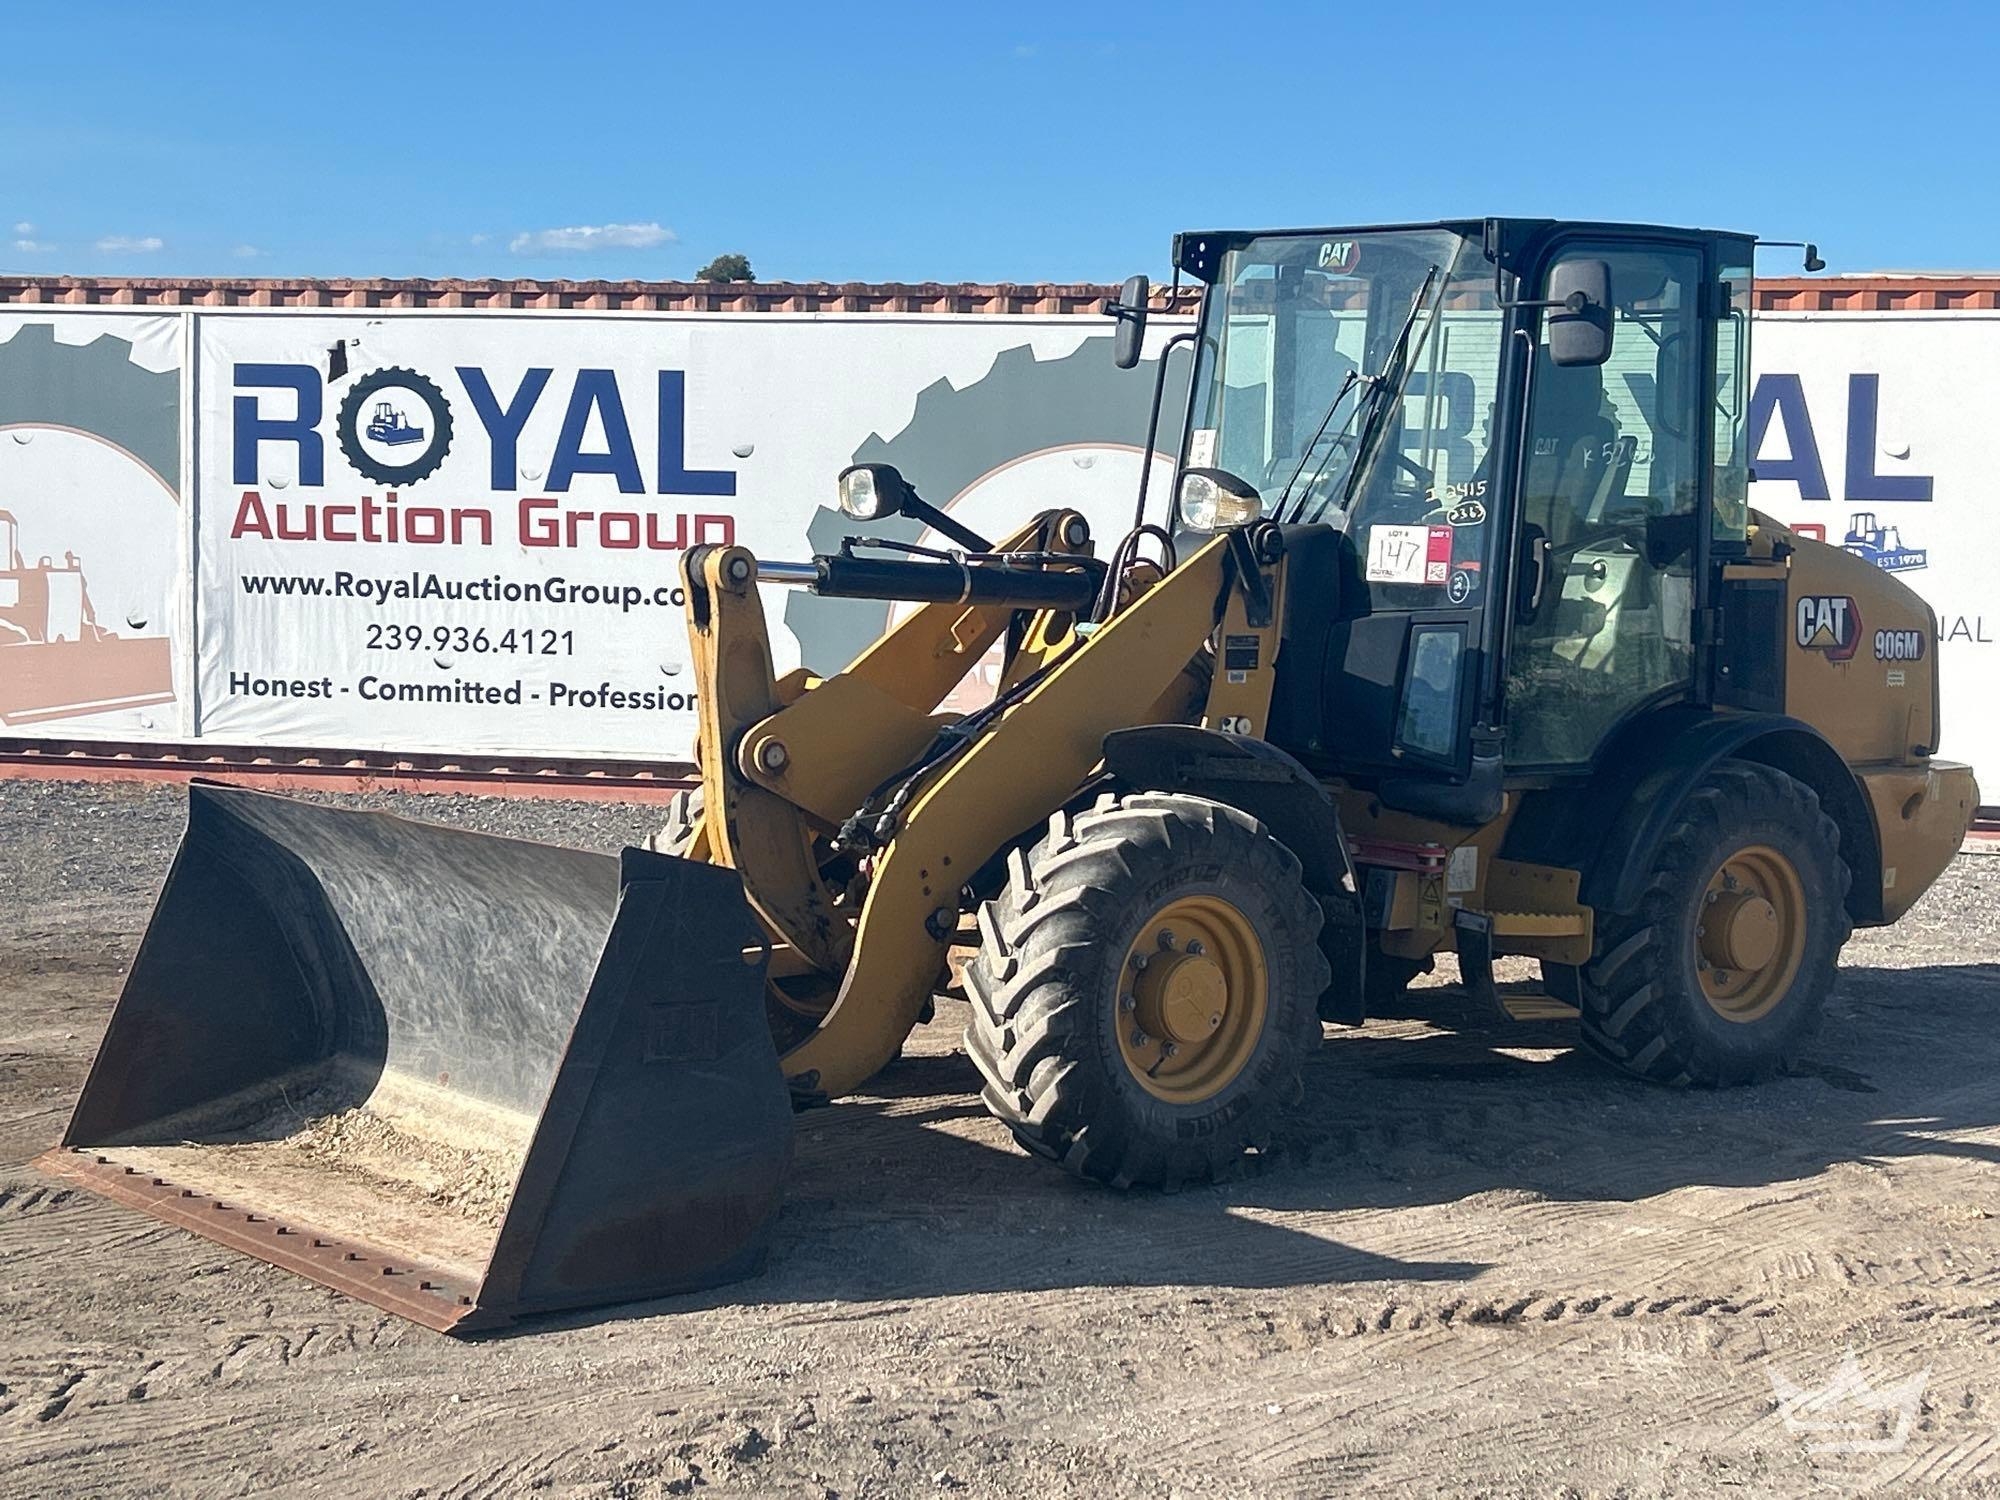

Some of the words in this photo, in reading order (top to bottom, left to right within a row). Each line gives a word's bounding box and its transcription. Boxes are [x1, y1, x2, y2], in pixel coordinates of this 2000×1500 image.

[1318, 242, 1353, 268] CAT
[233, 363, 737, 496] ROYAL
[1446, 479, 1489, 500] 2415
[230, 491, 492, 546] Auction
[519, 498, 736, 551] Group
[1379, 539, 1421, 572] 147
[1898, 553, 1924, 566] 1970
[241, 571, 685, 613] www.RoyalAuctionGroup.co
[1797, 598, 1847, 647] CAT
[366, 623, 573, 656] 239.936.4121
[1874, 631, 1919, 660] 906M
[229, 671, 333, 699] Honest
[358, 675, 521, 705] Committed
[549, 682, 698, 711] Profession
